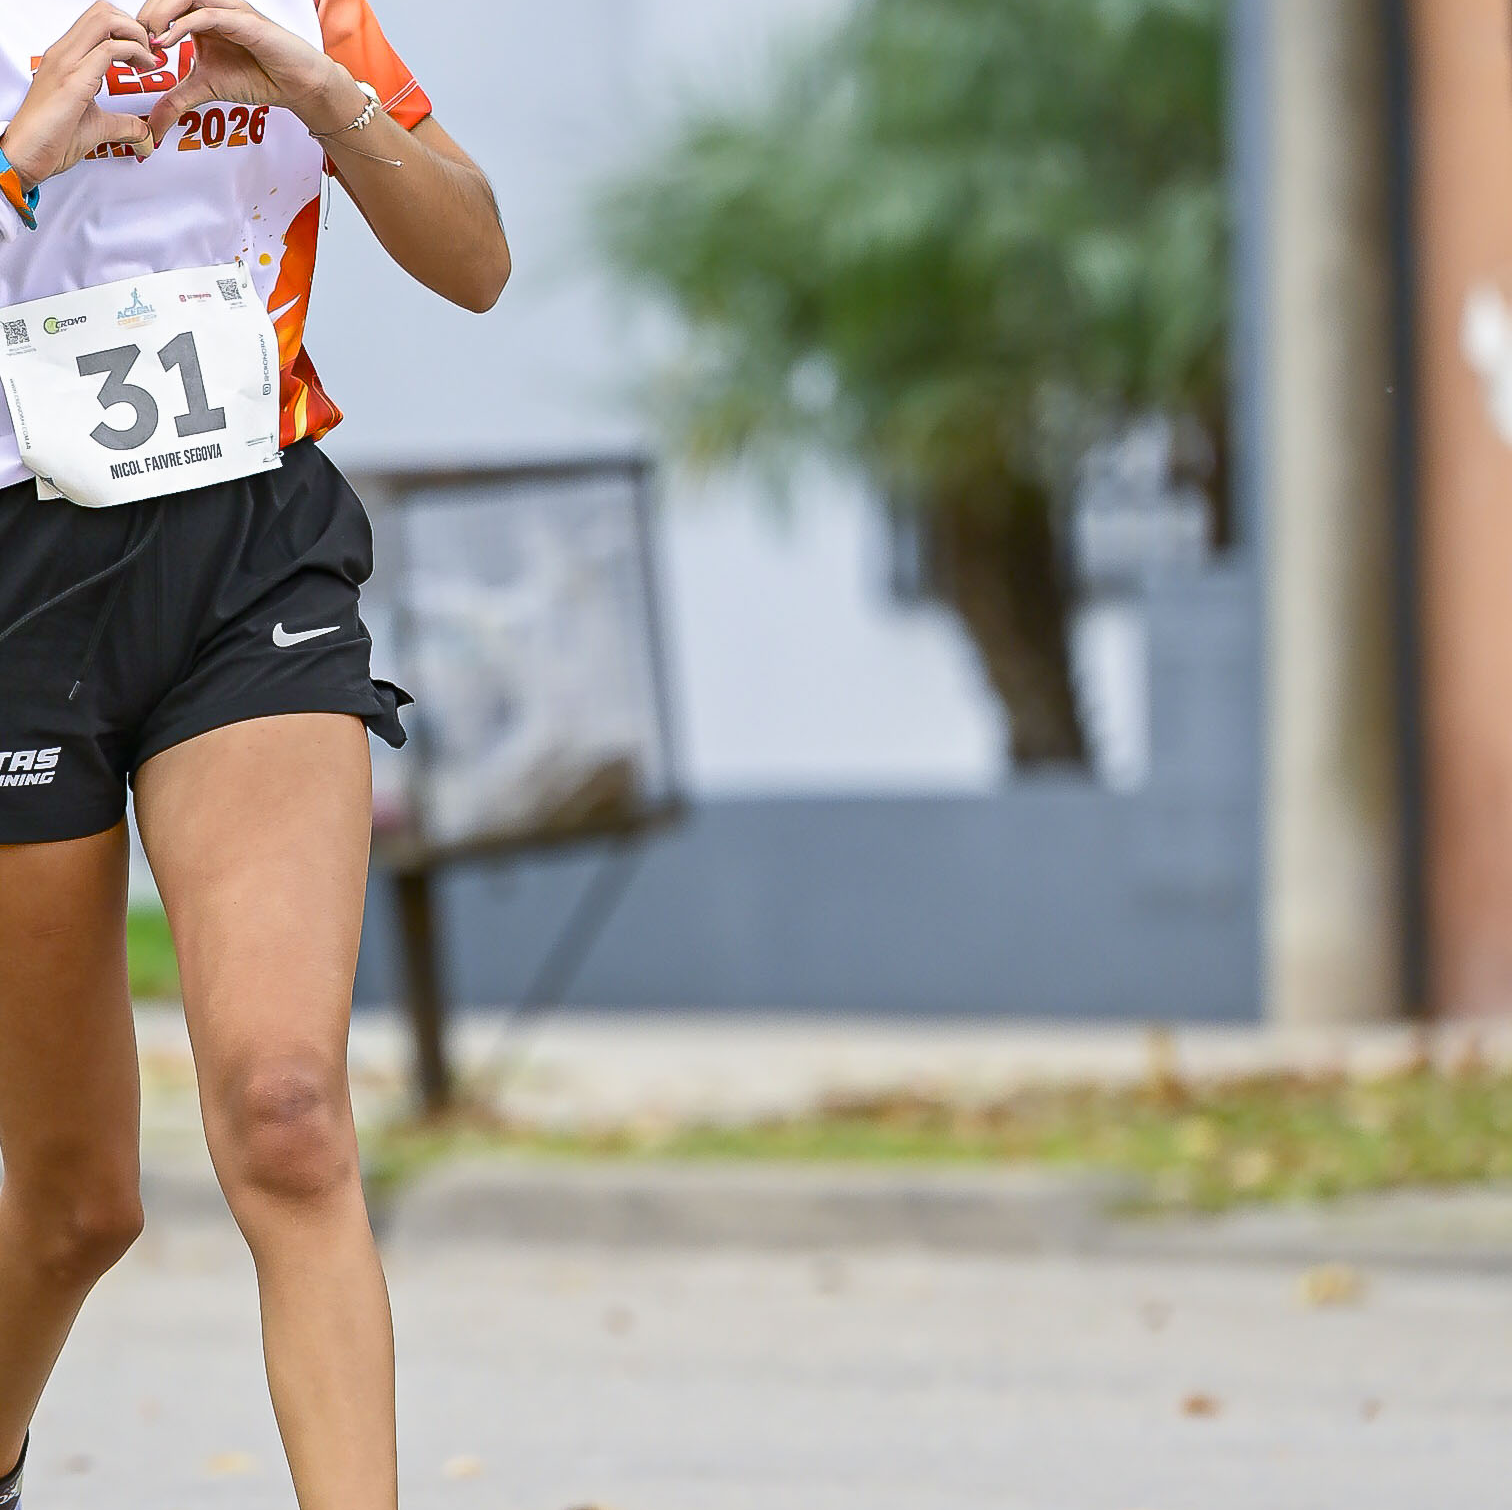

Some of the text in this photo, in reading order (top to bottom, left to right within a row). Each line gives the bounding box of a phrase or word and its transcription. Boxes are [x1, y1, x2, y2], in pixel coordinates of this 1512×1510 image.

[177, 105, 270, 152] 2026
[76, 331, 226, 450] 31
[110, 443, 223, 479] NICOL FAIVRE SEGOVIA
